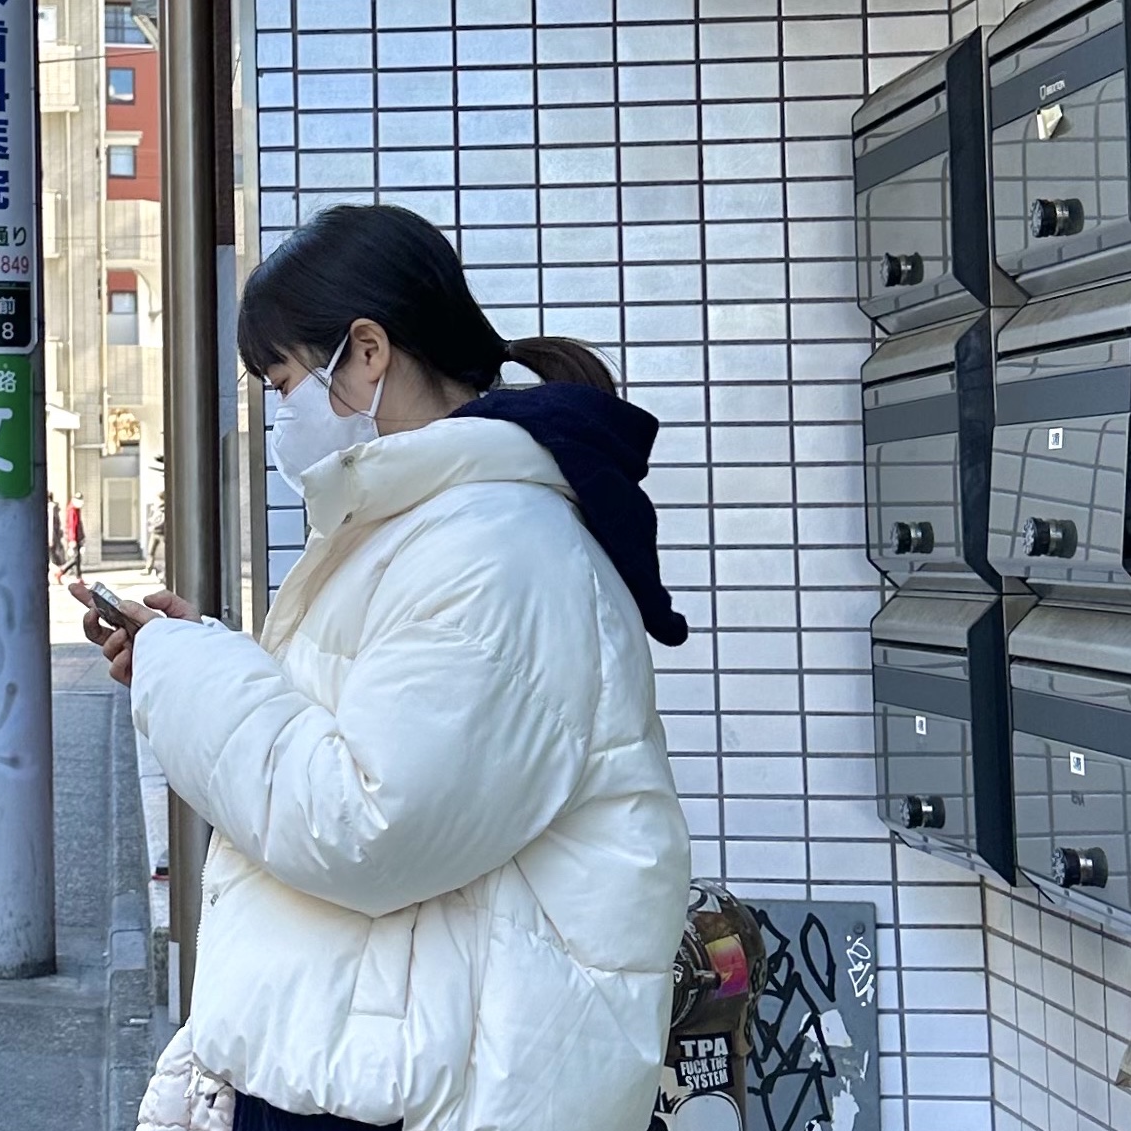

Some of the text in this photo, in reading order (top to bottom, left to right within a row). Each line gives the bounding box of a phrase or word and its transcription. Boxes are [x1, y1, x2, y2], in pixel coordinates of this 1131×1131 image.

[680, 1037, 729, 1057] TPA
[680, 1056, 728, 1076] FUCK THE
[685, 1069, 728, 1090] SYSTEM
